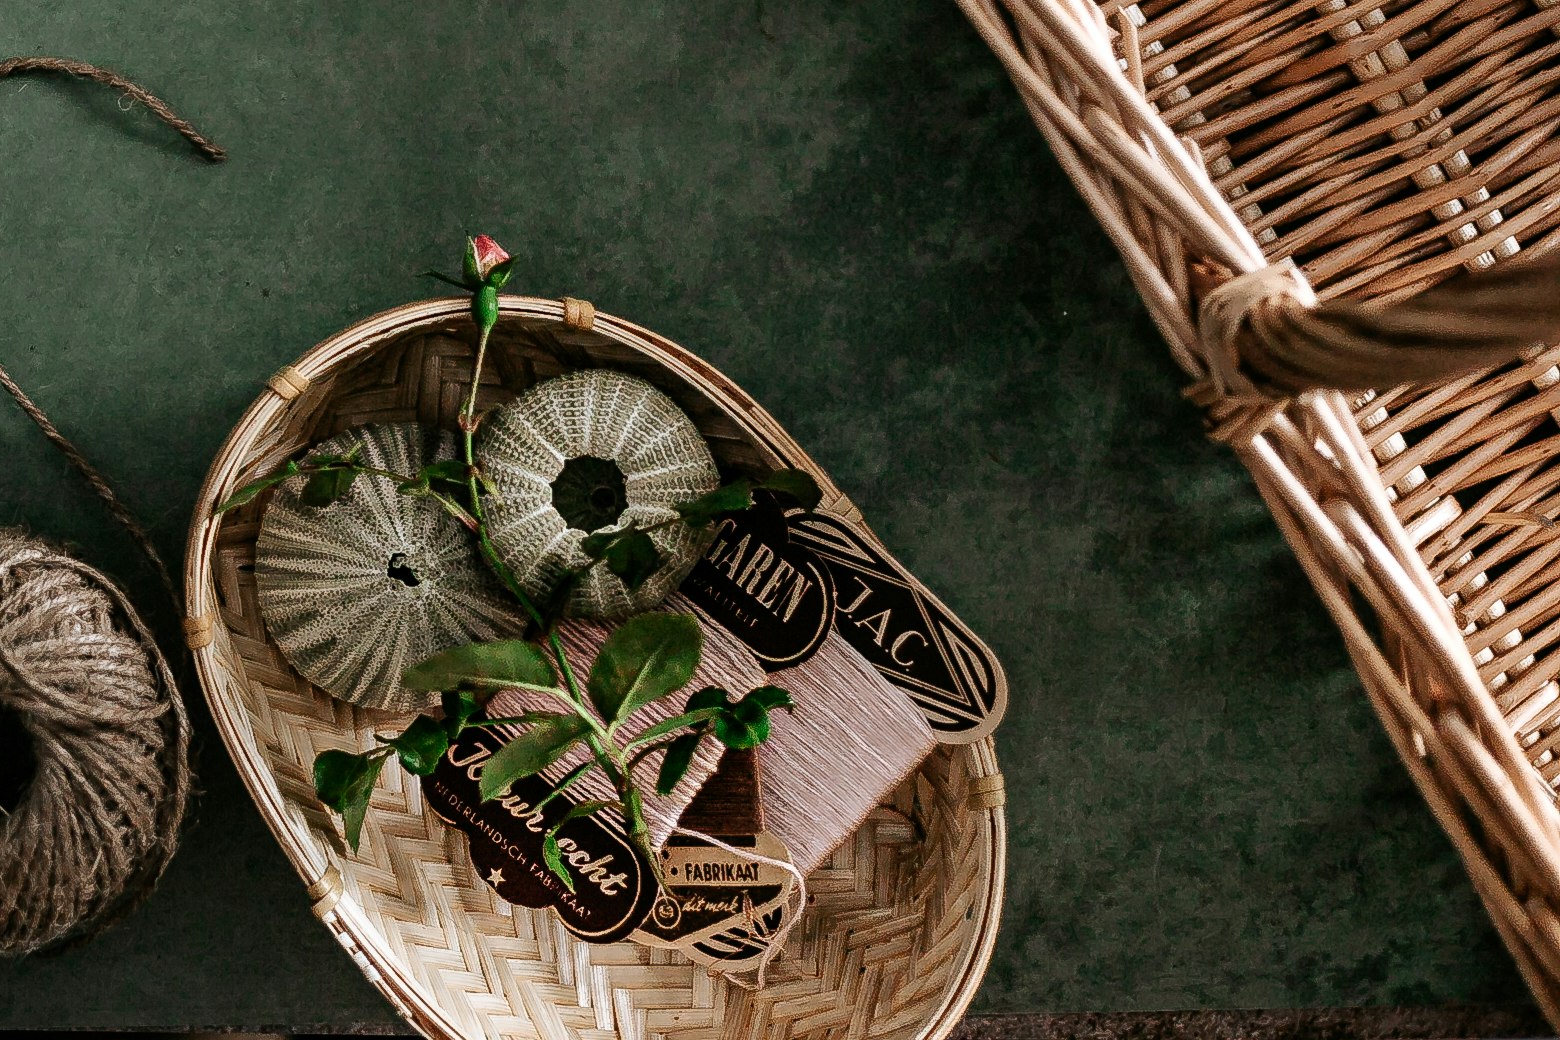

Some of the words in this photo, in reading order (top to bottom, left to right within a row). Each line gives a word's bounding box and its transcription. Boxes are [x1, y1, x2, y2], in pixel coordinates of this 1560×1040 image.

[707, 518, 813, 623] GAREN
[557, 837, 628, 896] echt
[685, 862, 759, 882] FABRIKAAT
